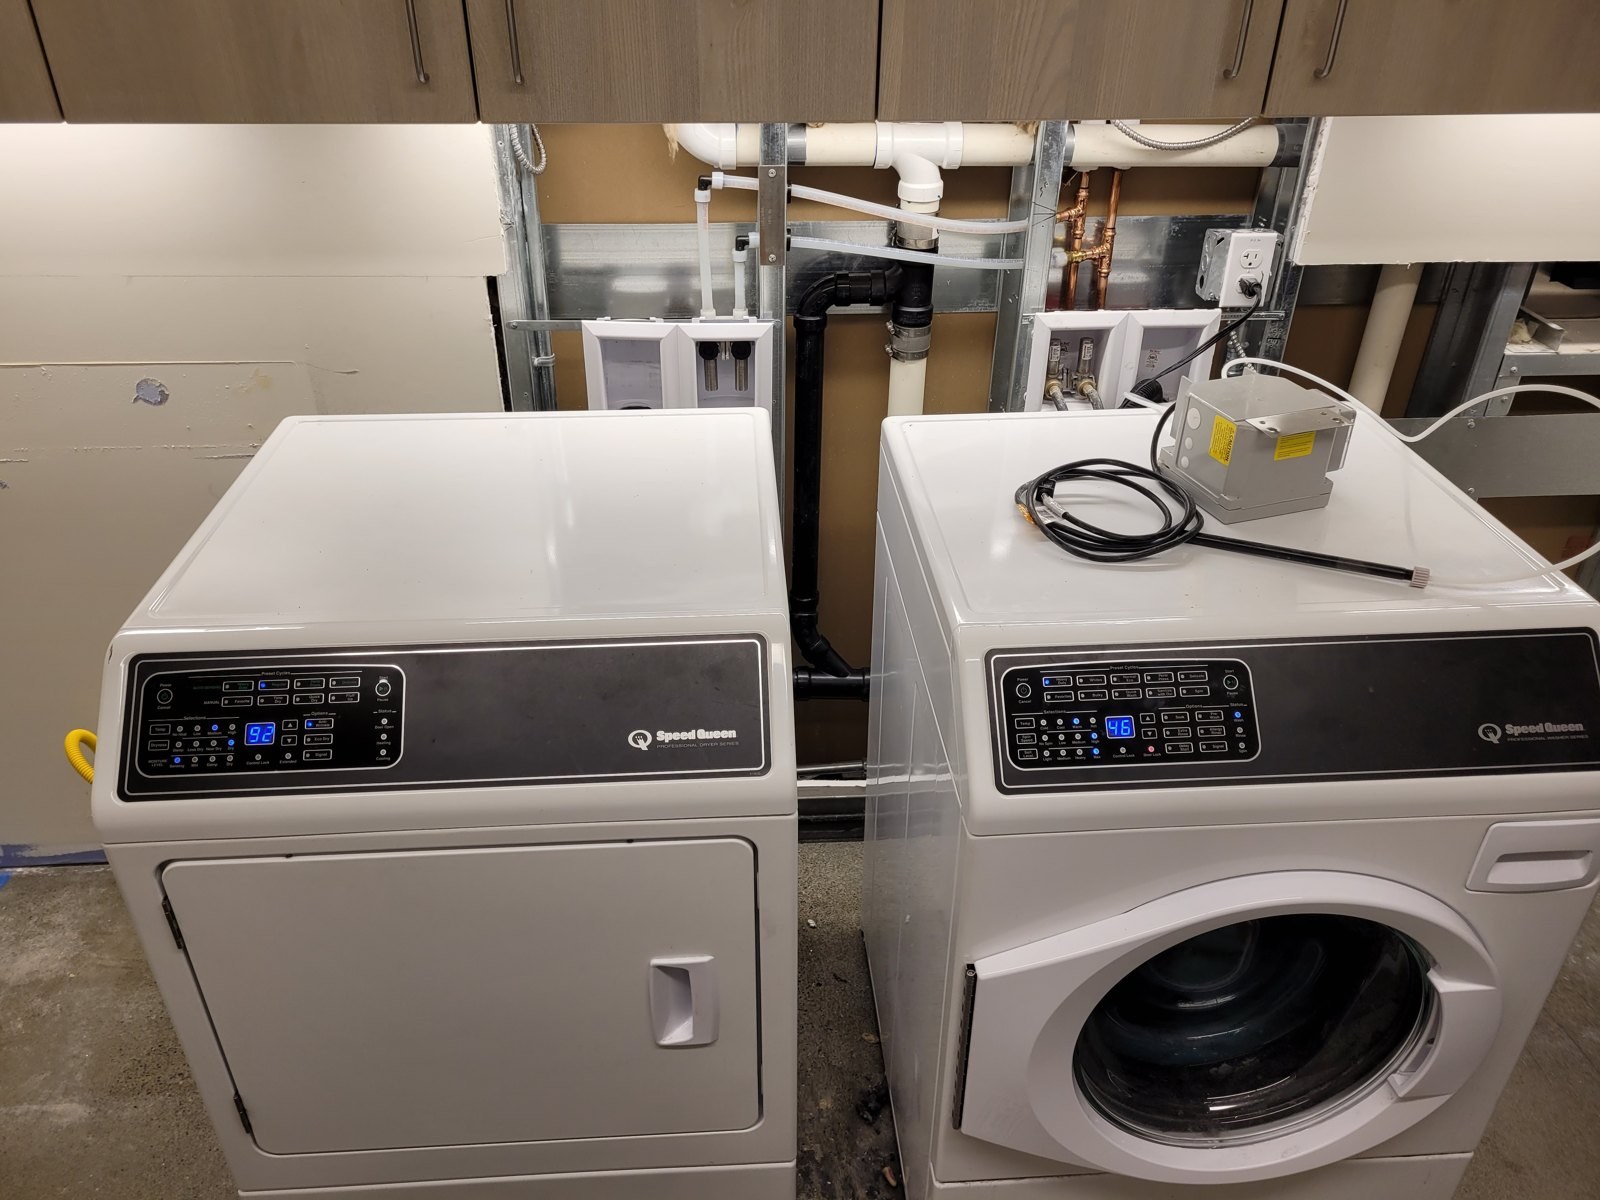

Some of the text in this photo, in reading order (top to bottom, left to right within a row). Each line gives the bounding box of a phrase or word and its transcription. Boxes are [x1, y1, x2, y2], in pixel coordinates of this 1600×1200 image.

[1225, 433, 1234, 463] CAUTION
[250, 726, 274, 743] 92
[656, 729, 736, 743] Speed Queen
[1108, 720, 1130, 736] 46
[1504, 722, 1584, 736] Speed Queen
